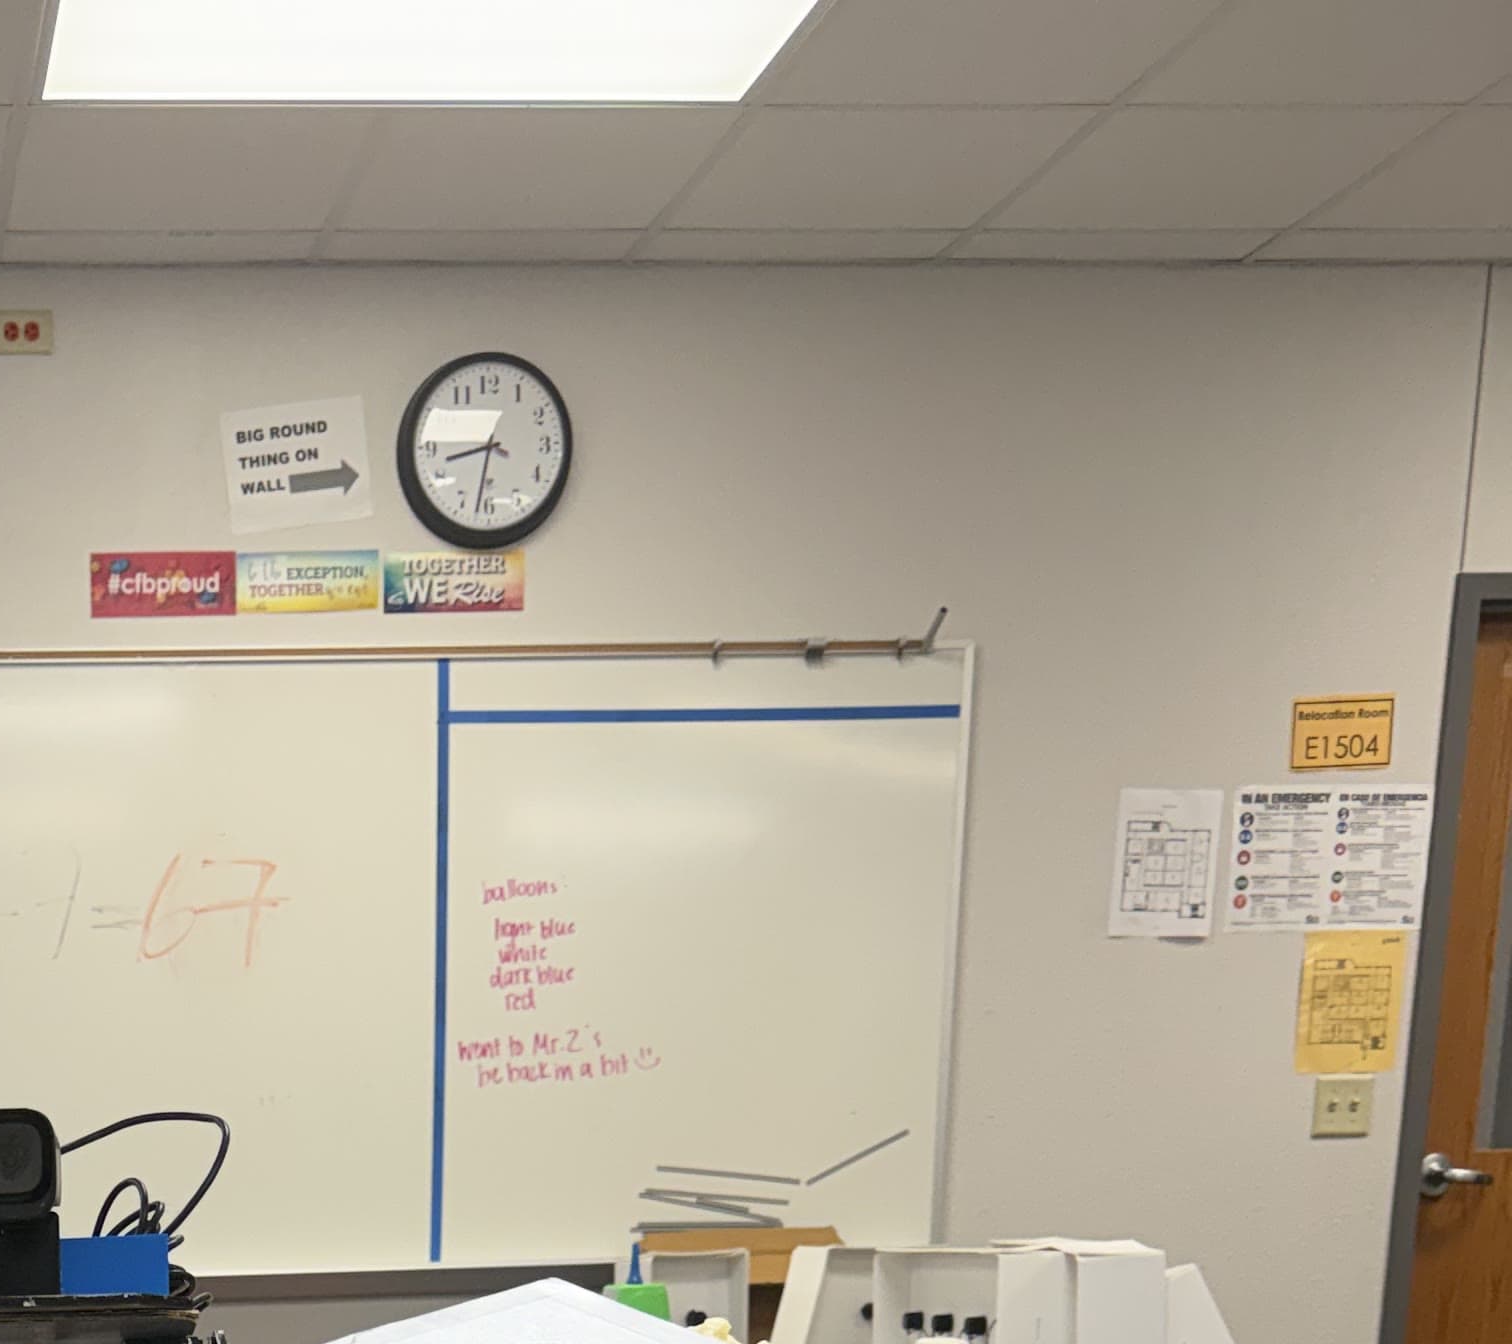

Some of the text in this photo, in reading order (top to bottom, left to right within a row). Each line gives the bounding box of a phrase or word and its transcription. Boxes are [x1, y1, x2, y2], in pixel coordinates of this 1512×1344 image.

[236, 420, 328, 444] BIG ROUND
[239, 448, 319, 470] THING ON
[241, 478, 286, 495] WALL
[403, 555, 506, 575] TOGETHER
[249, 583, 324, 598] TOGETHER
[403, 577, 449, 604] WE
[1305, 734, 1379, 760] E1504
[540, 918, 576, 940] blue
[505, 988, 536, 1011] red
